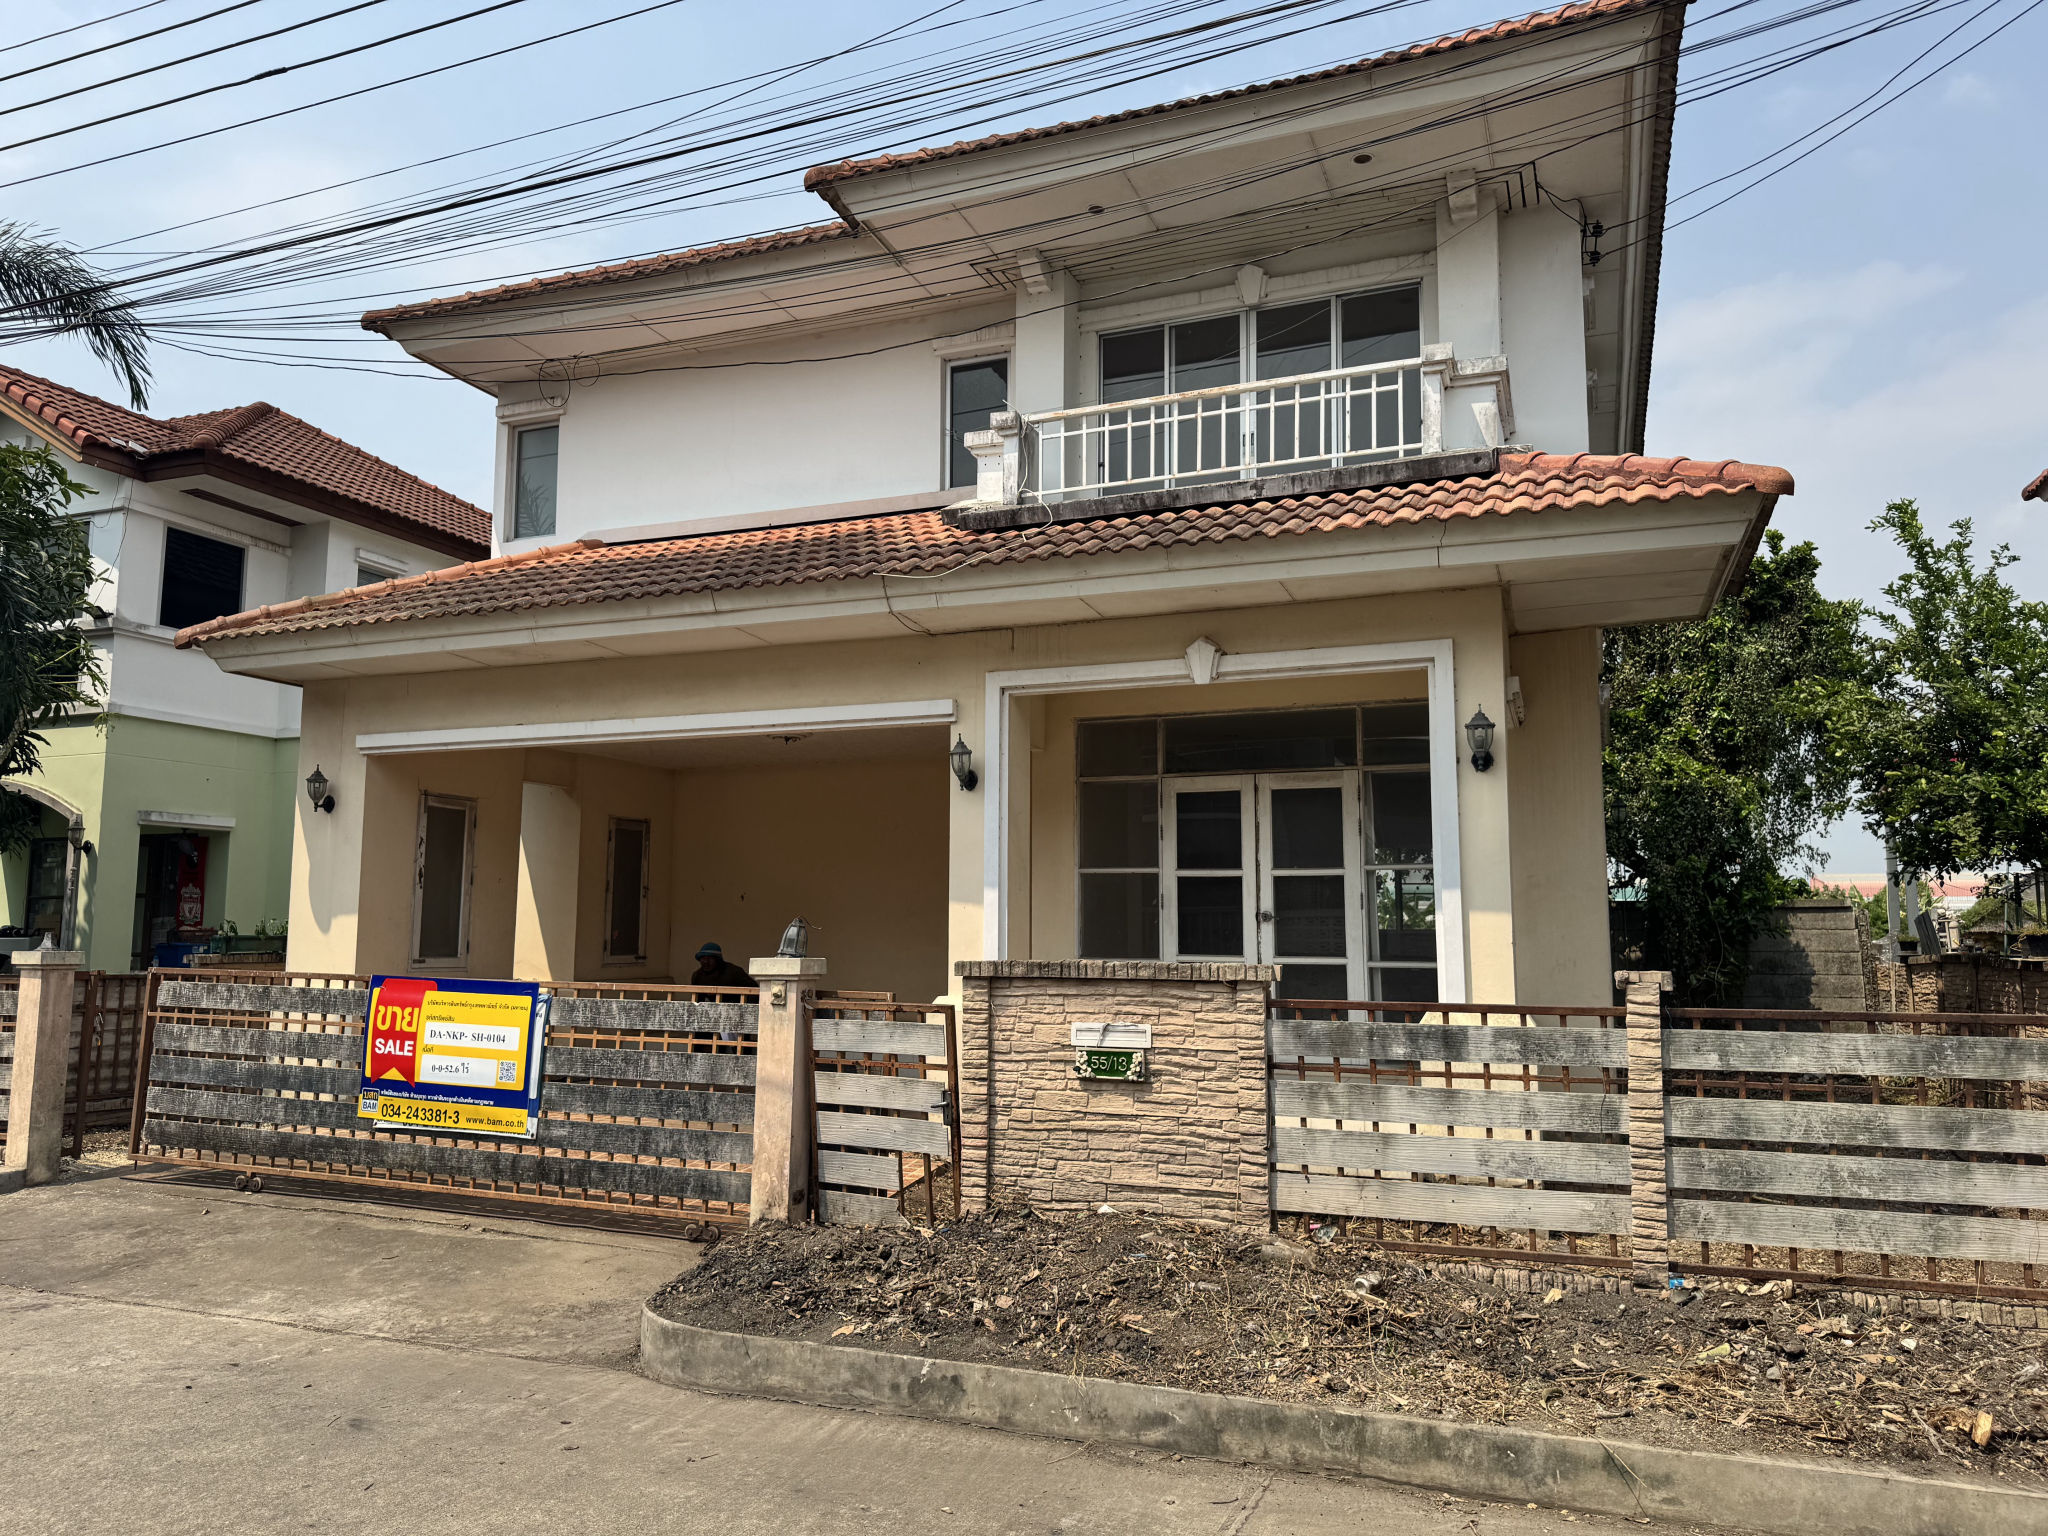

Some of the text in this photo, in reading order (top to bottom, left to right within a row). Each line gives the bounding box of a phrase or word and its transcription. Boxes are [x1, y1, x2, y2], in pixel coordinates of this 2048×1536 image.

[376, 1005, 419, 1032] ขาย
[471, 1032, 506, 1043] SH-0104
[375, 1037, 415, 1056] SALE
[431, 1064, 460, 1073] 0-0-52.6
[1091, 1056, 1128, 1071] 55/13
[362, 1101, 377, 1110] BAM
[381, 1104, 524, 1128] 034-243381-3 www.bam.co.th
